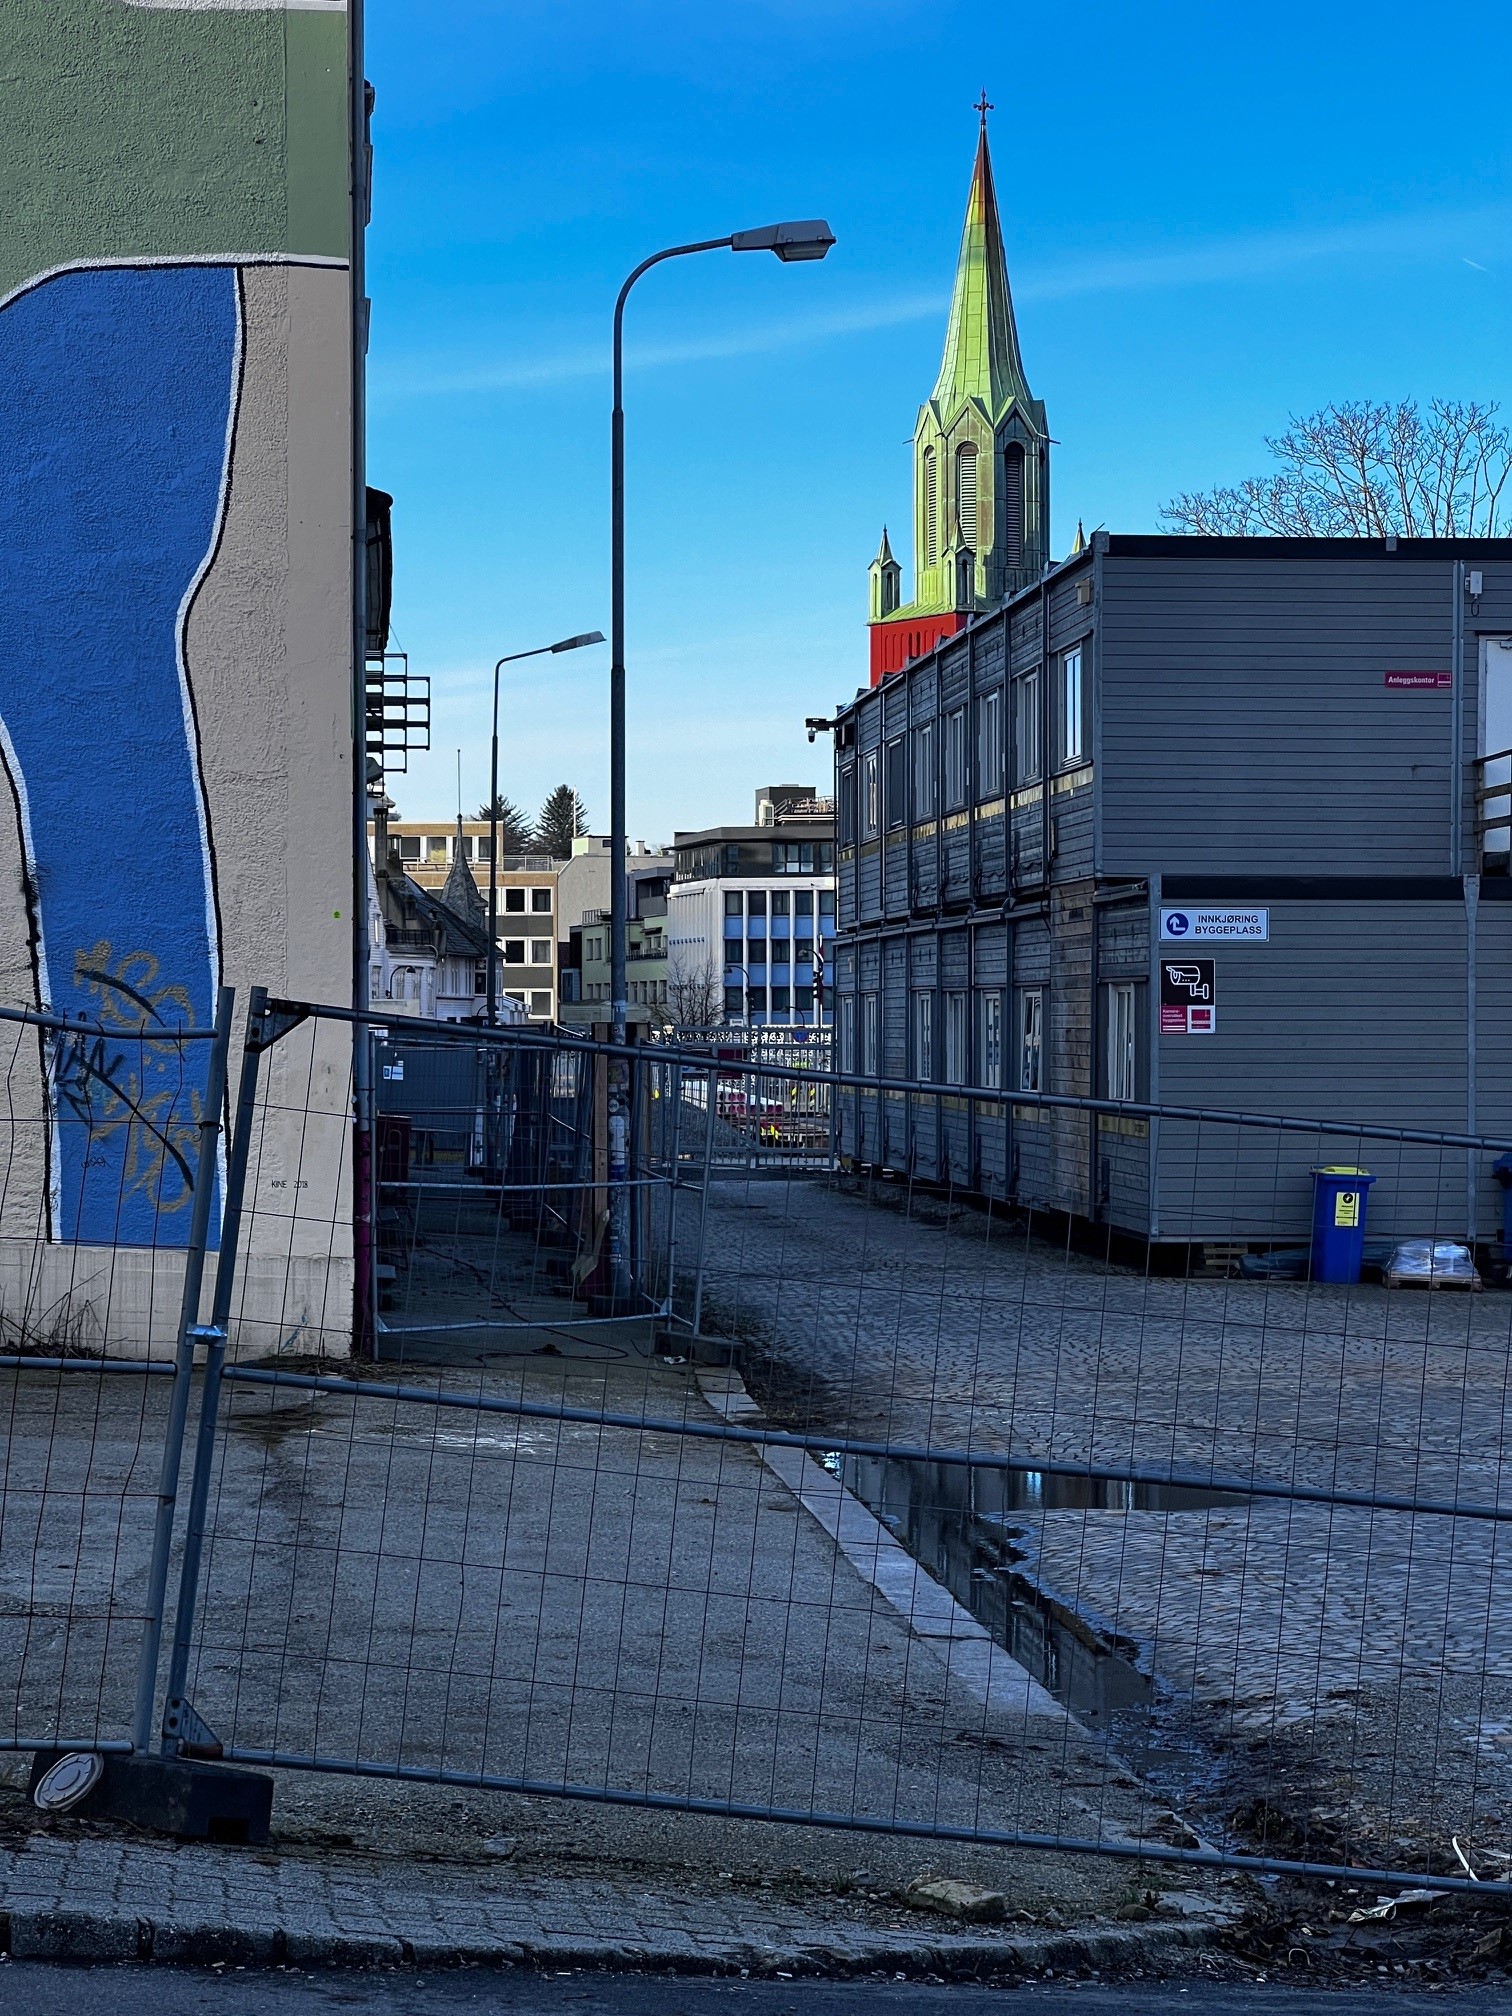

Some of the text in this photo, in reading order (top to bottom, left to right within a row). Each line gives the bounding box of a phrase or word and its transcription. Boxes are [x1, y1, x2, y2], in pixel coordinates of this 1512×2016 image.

[1388, 676, 1435, 685] Anleggskontor
[1198, 915, 1259, 923] INNKJØRING
[1195, 926, 1262, 934] BYGGEPLASS
